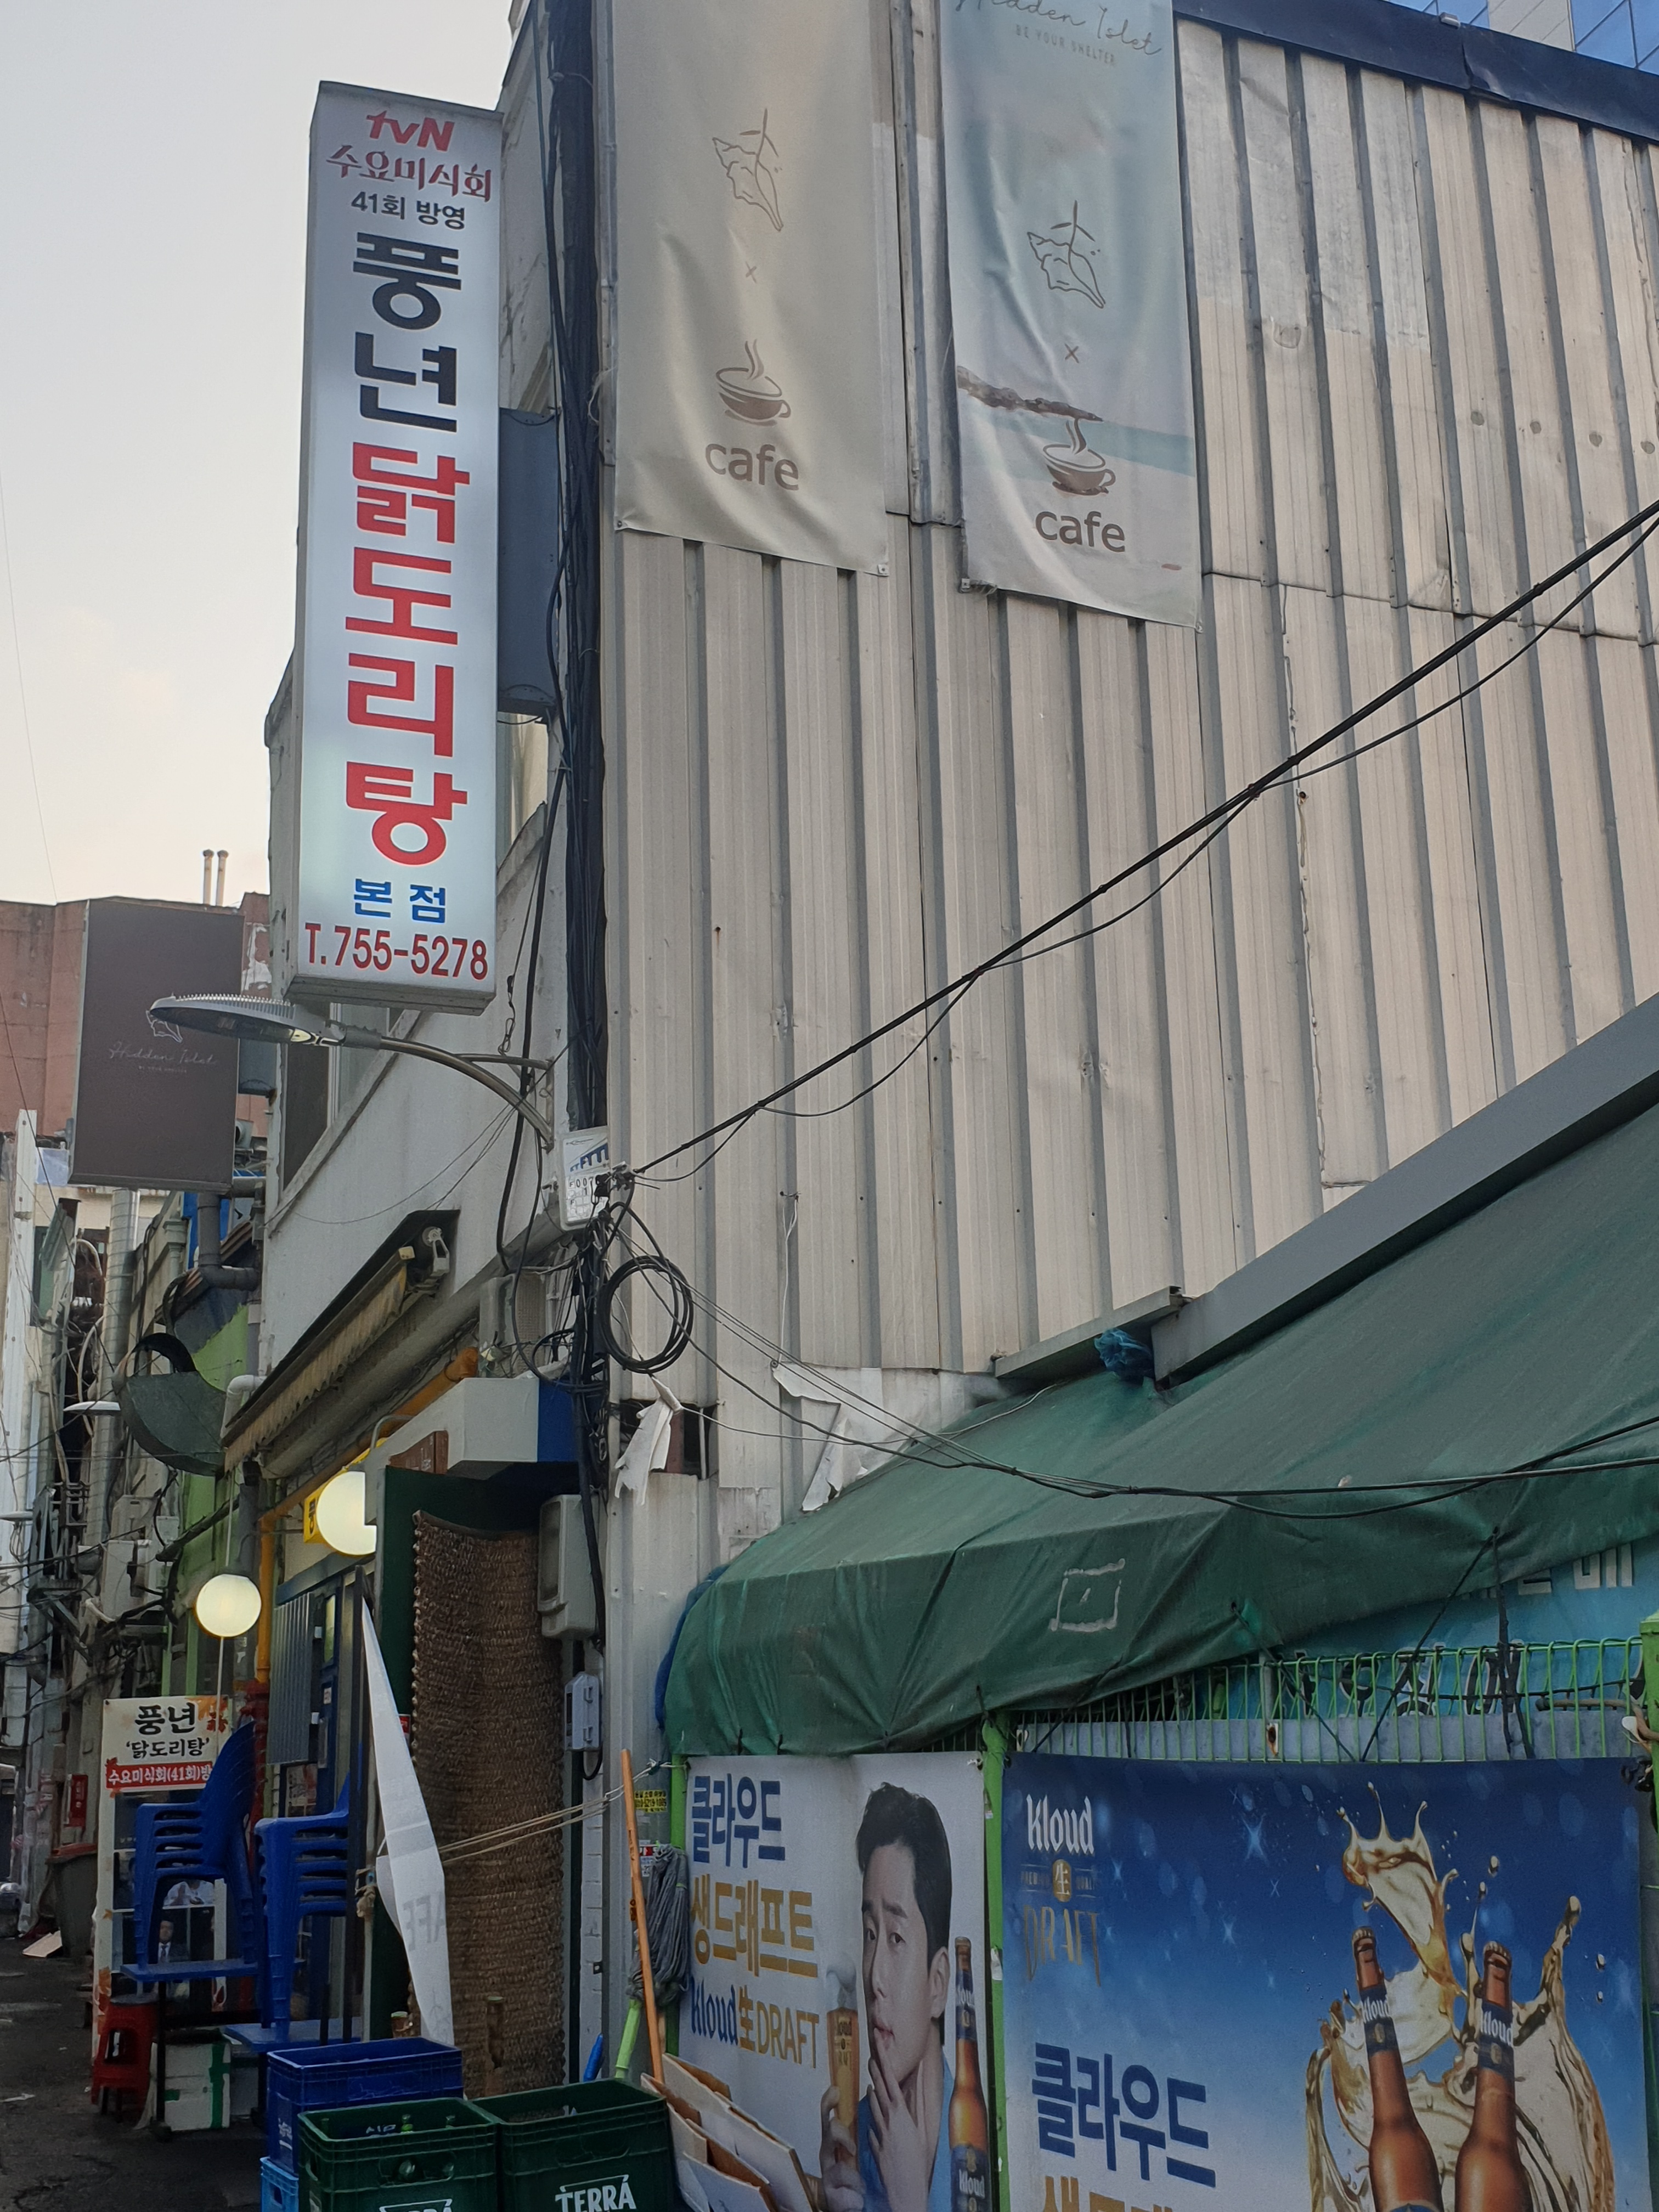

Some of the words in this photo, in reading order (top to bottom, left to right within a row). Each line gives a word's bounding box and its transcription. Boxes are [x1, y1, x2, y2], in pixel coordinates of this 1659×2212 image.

[366, 110, 455, 151] tvN
[326, 145, 492, 202] 수요미식회
[351, 191, 405, 220] 41회
[416, 200, 465, 230] 방영
[706, 443, 799, 490] cafe
[1035, 511, 1125, 552] cafe
[135, 1702, 195, 1735] 풍년
[692, 1773, 786, 1868] 클라우드
[1025, 1793, 1094, 1856] Kloud
[691, 1873, 818, 1977] 생드래프트
[1032, 2041, 1216, 2188] 클라우드
[555, 2181, 636, 2212] TERRA
